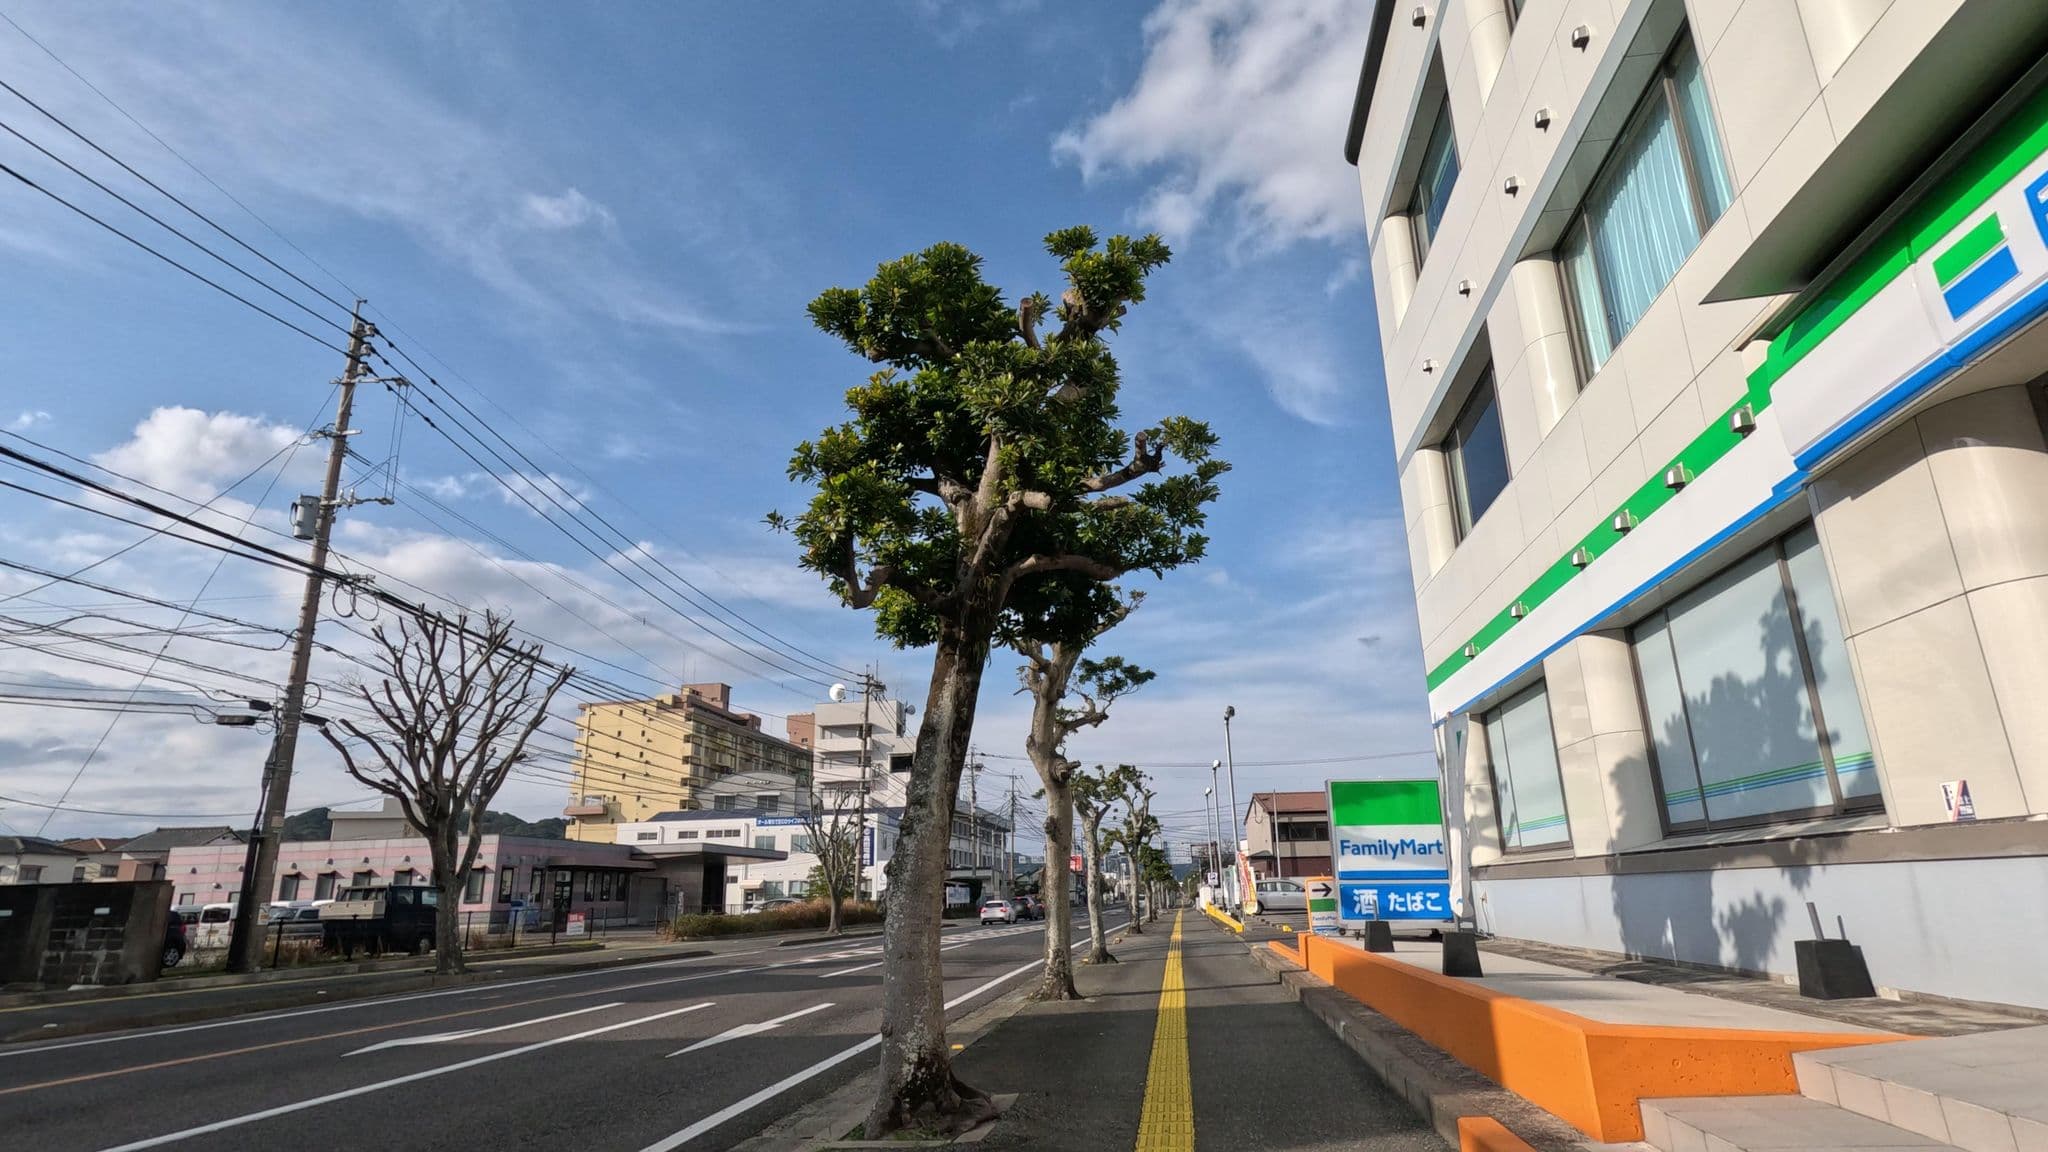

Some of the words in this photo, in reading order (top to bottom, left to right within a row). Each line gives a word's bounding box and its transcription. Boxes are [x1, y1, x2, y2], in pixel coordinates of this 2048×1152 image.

[1340, 839, 1443, 860] FamilyMart
[1352, 888, 1379, 915] 酒
[1387, 891, 1443, 912] たばこ
